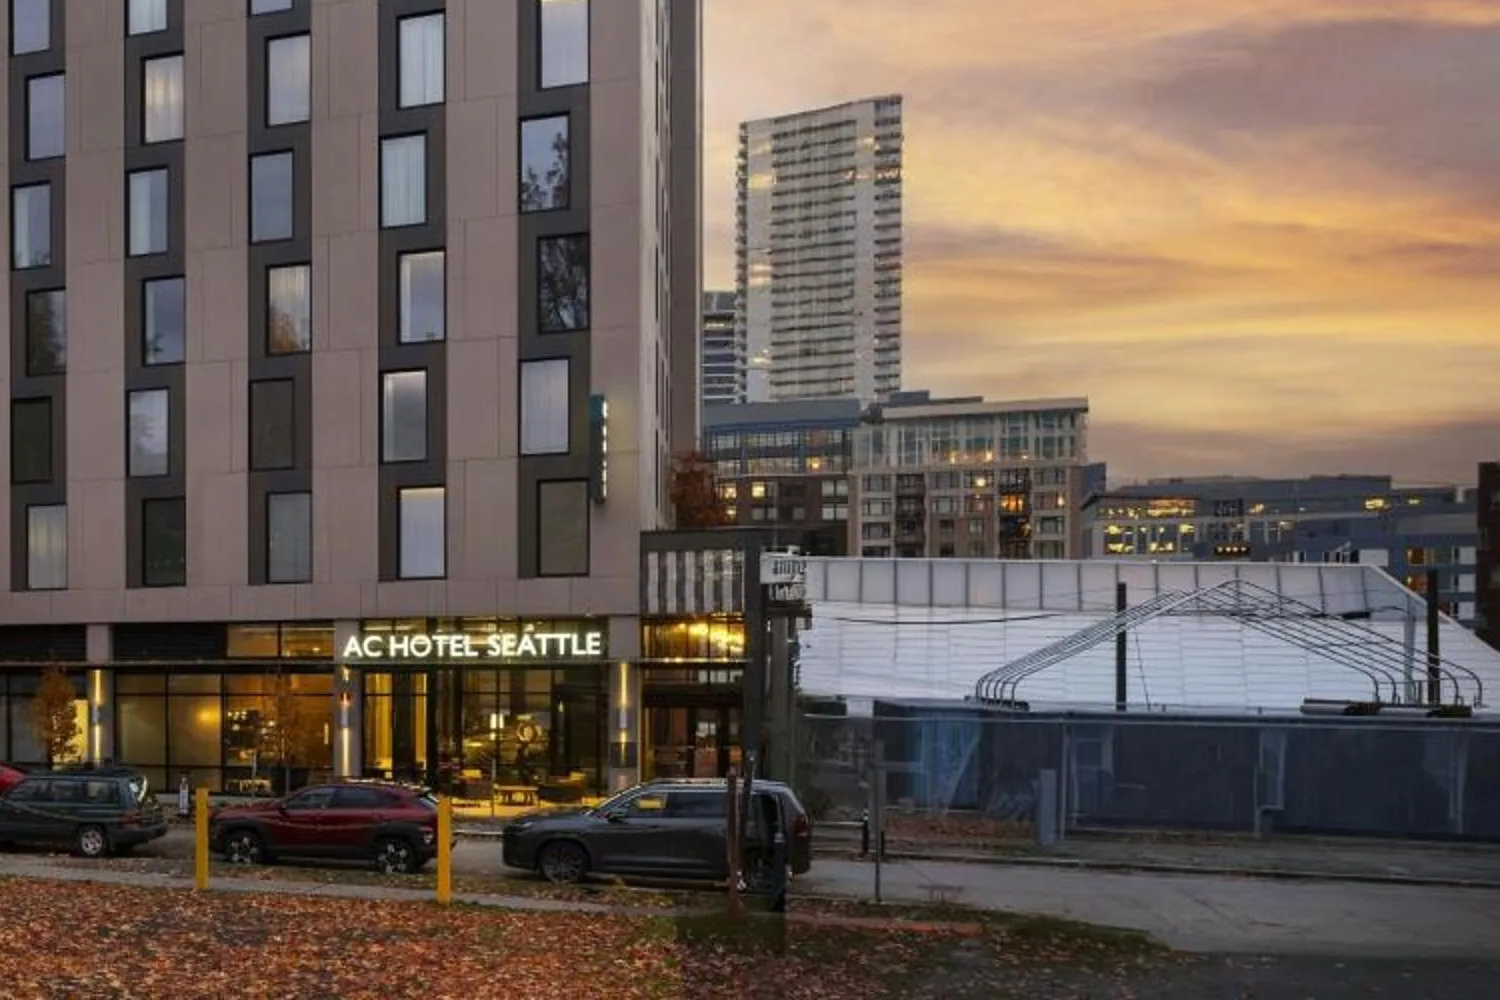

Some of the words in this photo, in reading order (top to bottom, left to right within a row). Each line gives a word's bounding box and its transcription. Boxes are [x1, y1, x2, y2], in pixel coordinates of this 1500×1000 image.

[343, 635, 383, 658] AC
[389, 634, 479, 657] HOTEL
[487, 632, 601, 656] SEATTLE
